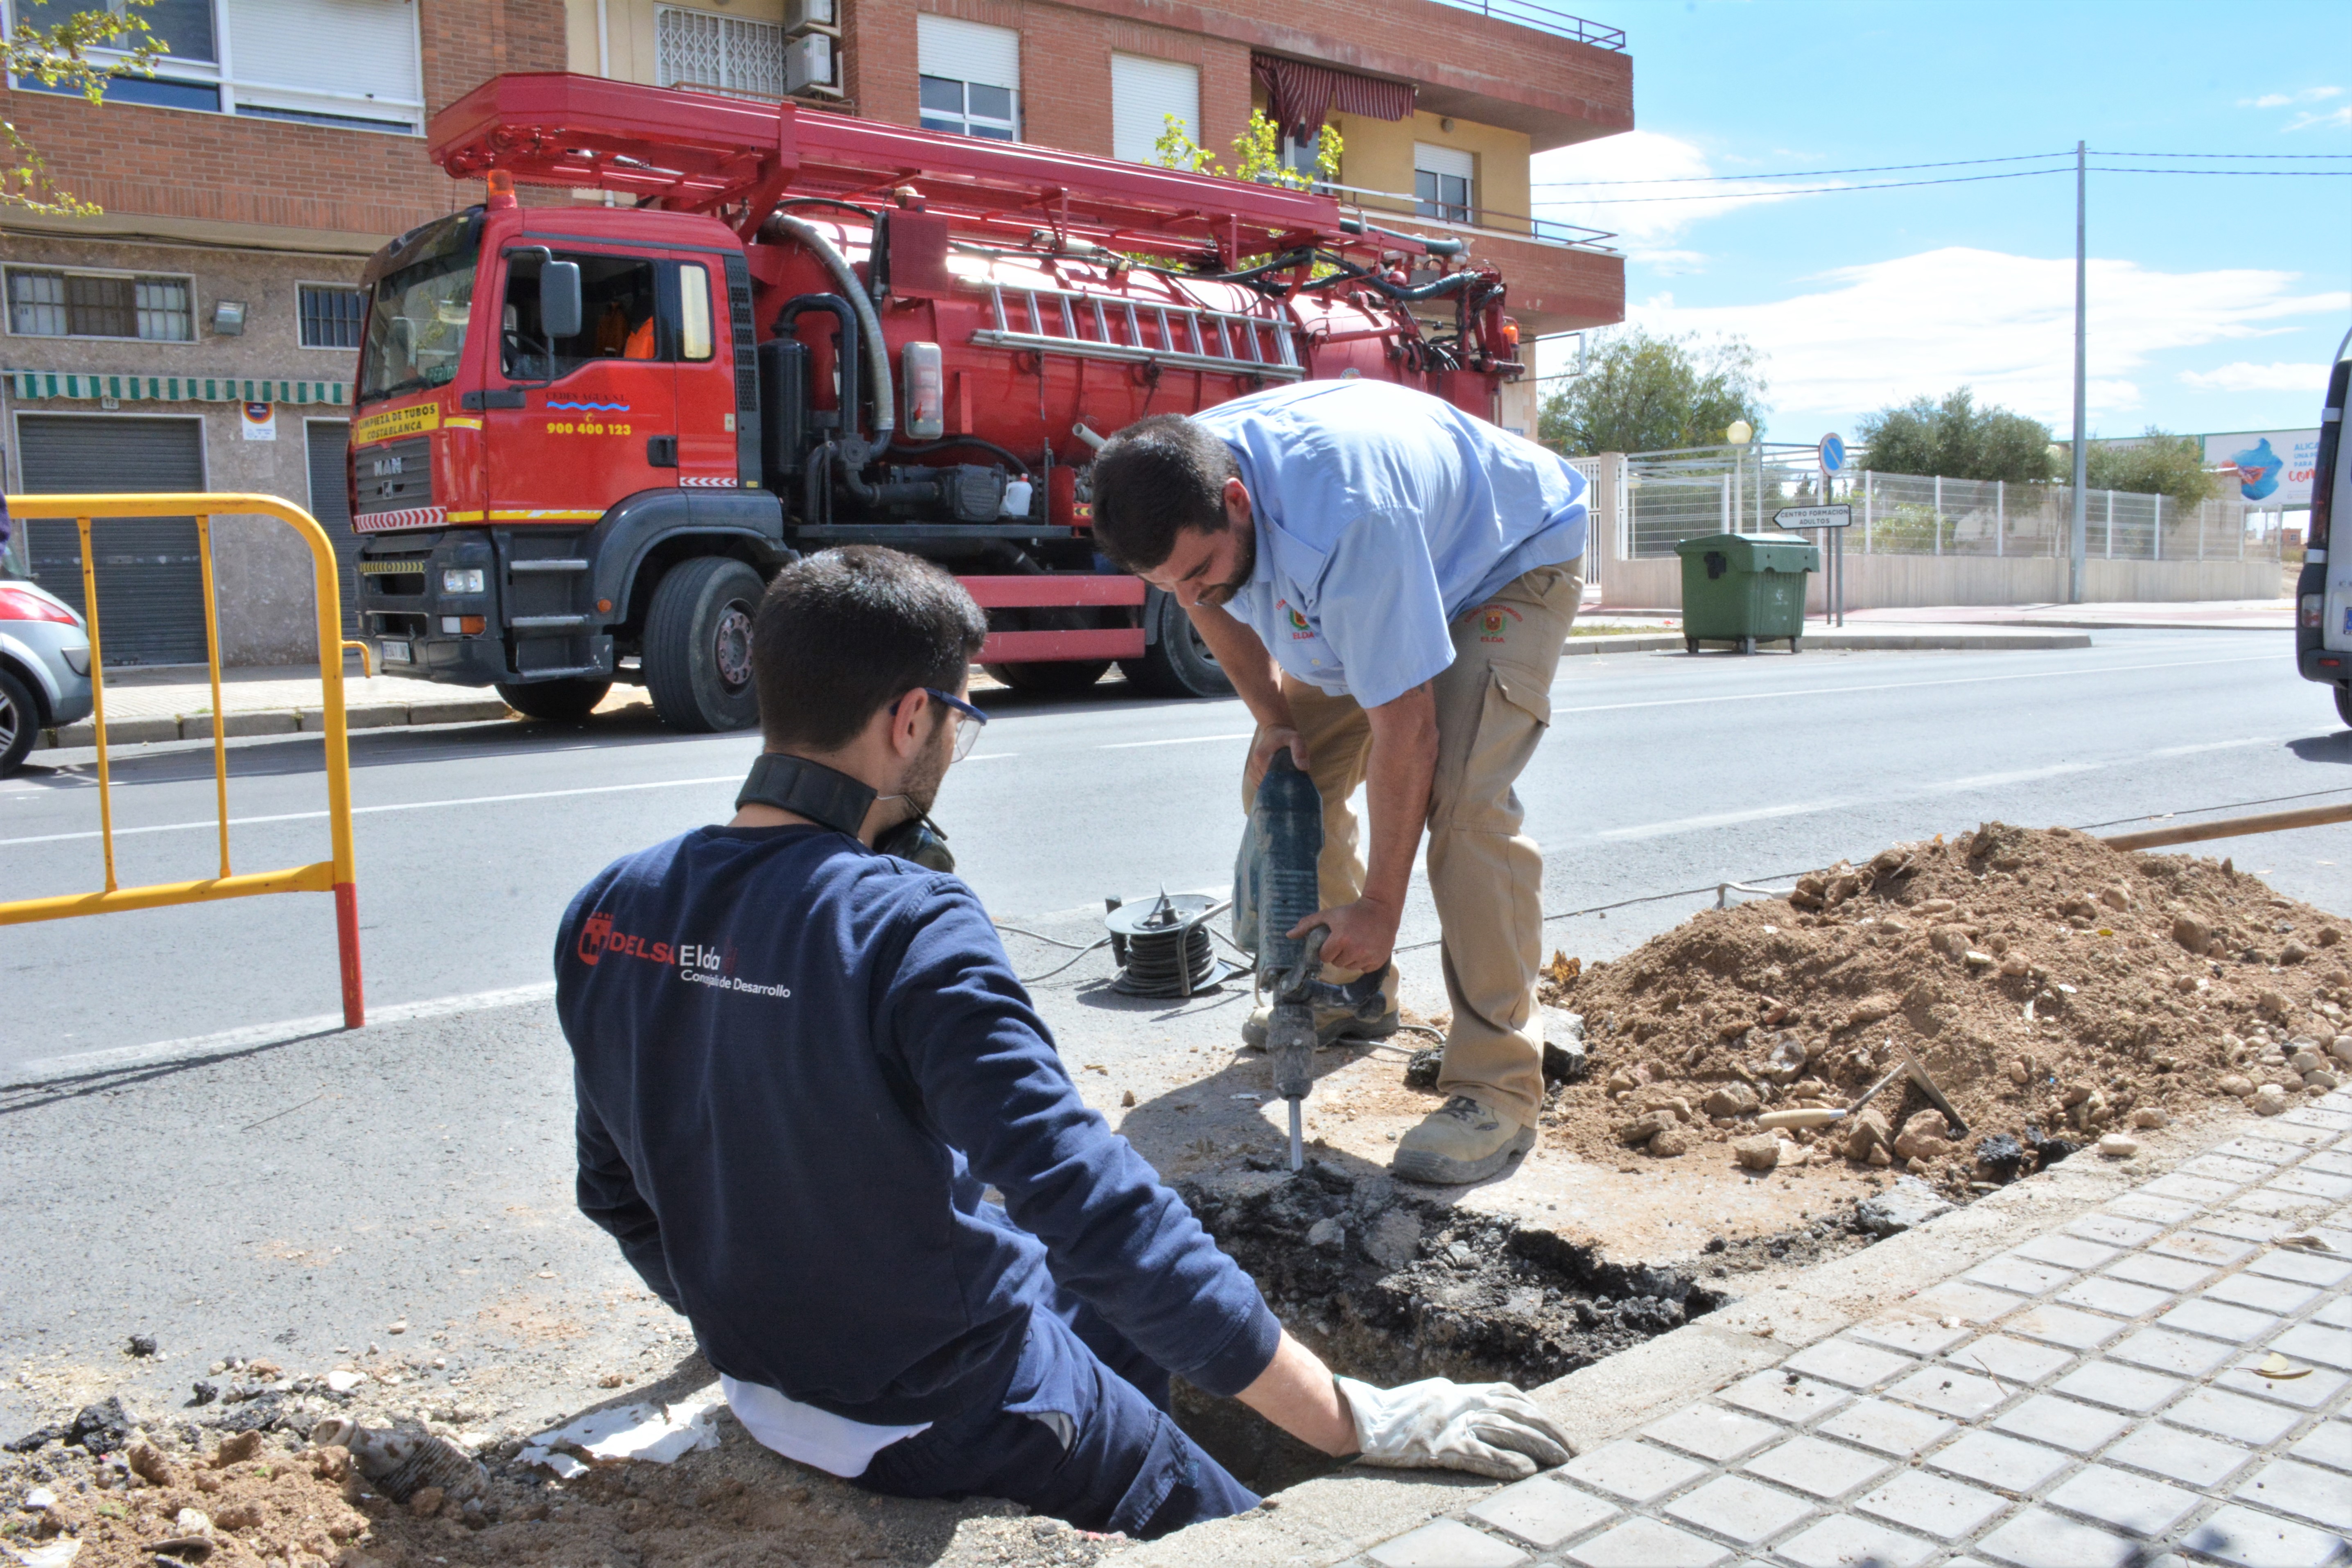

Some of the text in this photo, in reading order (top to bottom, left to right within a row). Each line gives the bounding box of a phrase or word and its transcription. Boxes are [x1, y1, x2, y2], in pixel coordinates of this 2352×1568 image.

[359, 404, 435, 430] LIMPIEZA DE TUBOS
[367, 420, 422, 441] COSTABLANCA
[547, 423, 631, 435] 900 400 123
[2294, 442, 2319, 450] ALICA
[374, 457, 402, 477] MAN
[1292, 631, 1315, 639] ELDA
[680, 944, 721, 970] Elda
[719, 976, 731, 989] de
[733, 978, 791, 998] Desarrollo
